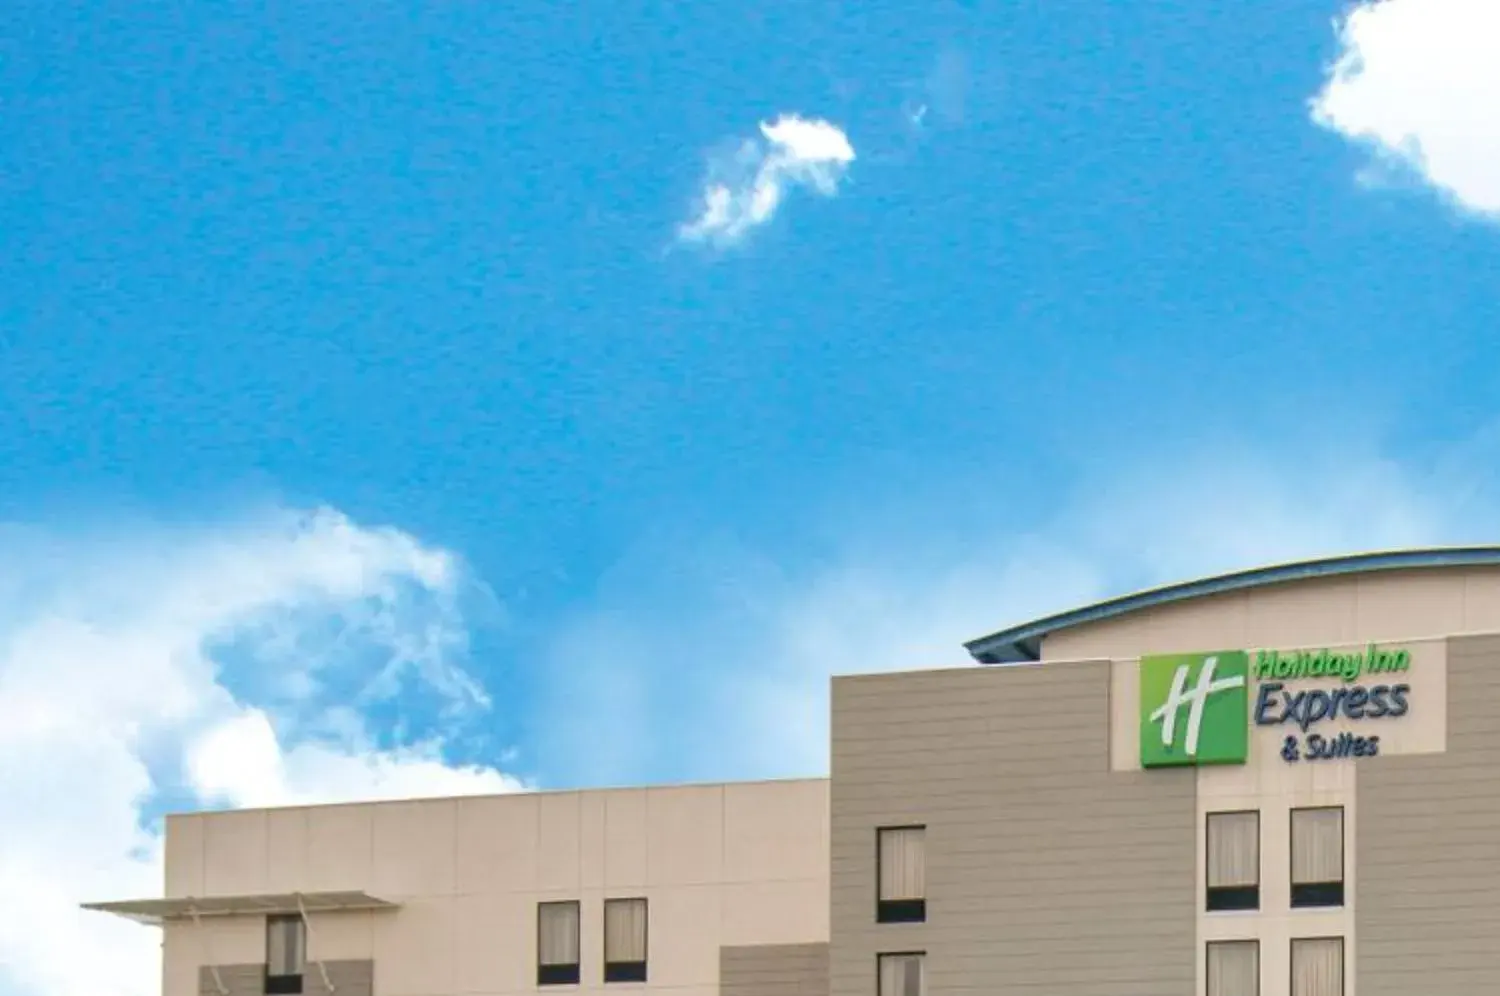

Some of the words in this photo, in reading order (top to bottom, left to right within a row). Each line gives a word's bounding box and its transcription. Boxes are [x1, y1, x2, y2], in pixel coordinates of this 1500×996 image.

[1254, 648, 1362, 682] Holiday
[1366, 641, 1410, 673] Inn
[1150, 656, 1245, 755] H
[1255, 682, 1411, 733] Express
[1280, 734, 1299, 762] &
[1304, 731, 1380, 760] Suites
